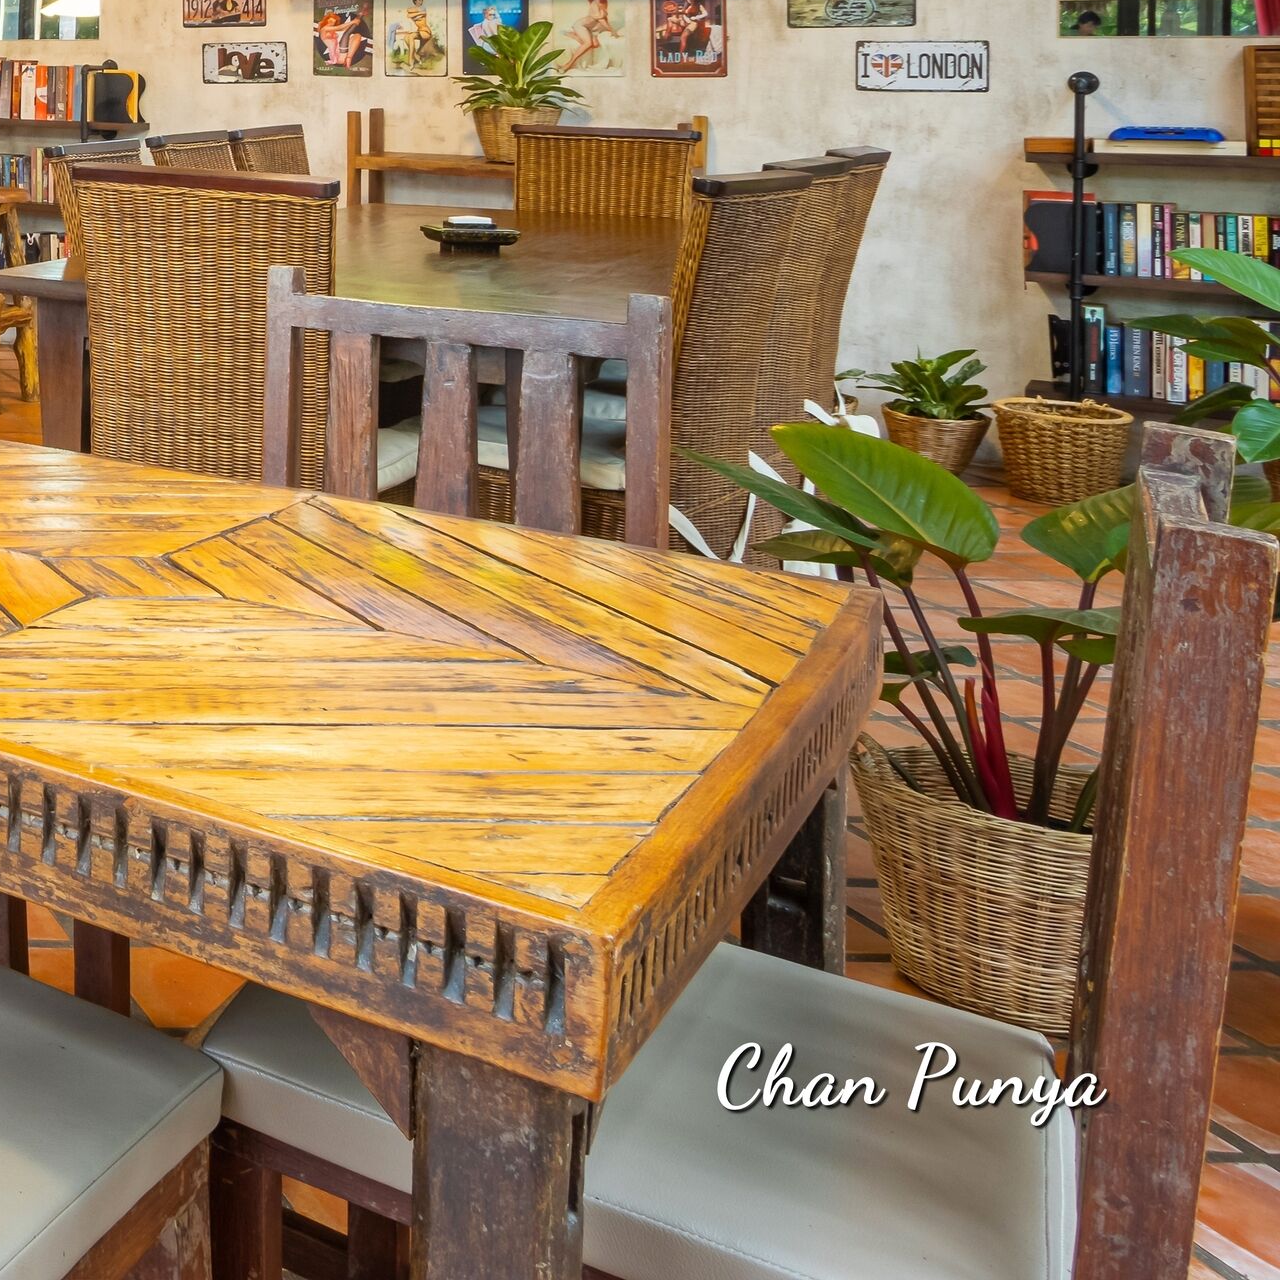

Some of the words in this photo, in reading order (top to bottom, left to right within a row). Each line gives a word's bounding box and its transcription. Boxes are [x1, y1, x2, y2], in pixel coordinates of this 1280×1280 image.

[659, 50, 688, 63] LADY
[861, 53, 870, 78] I
[907, 53, 983, 79] LONDON
